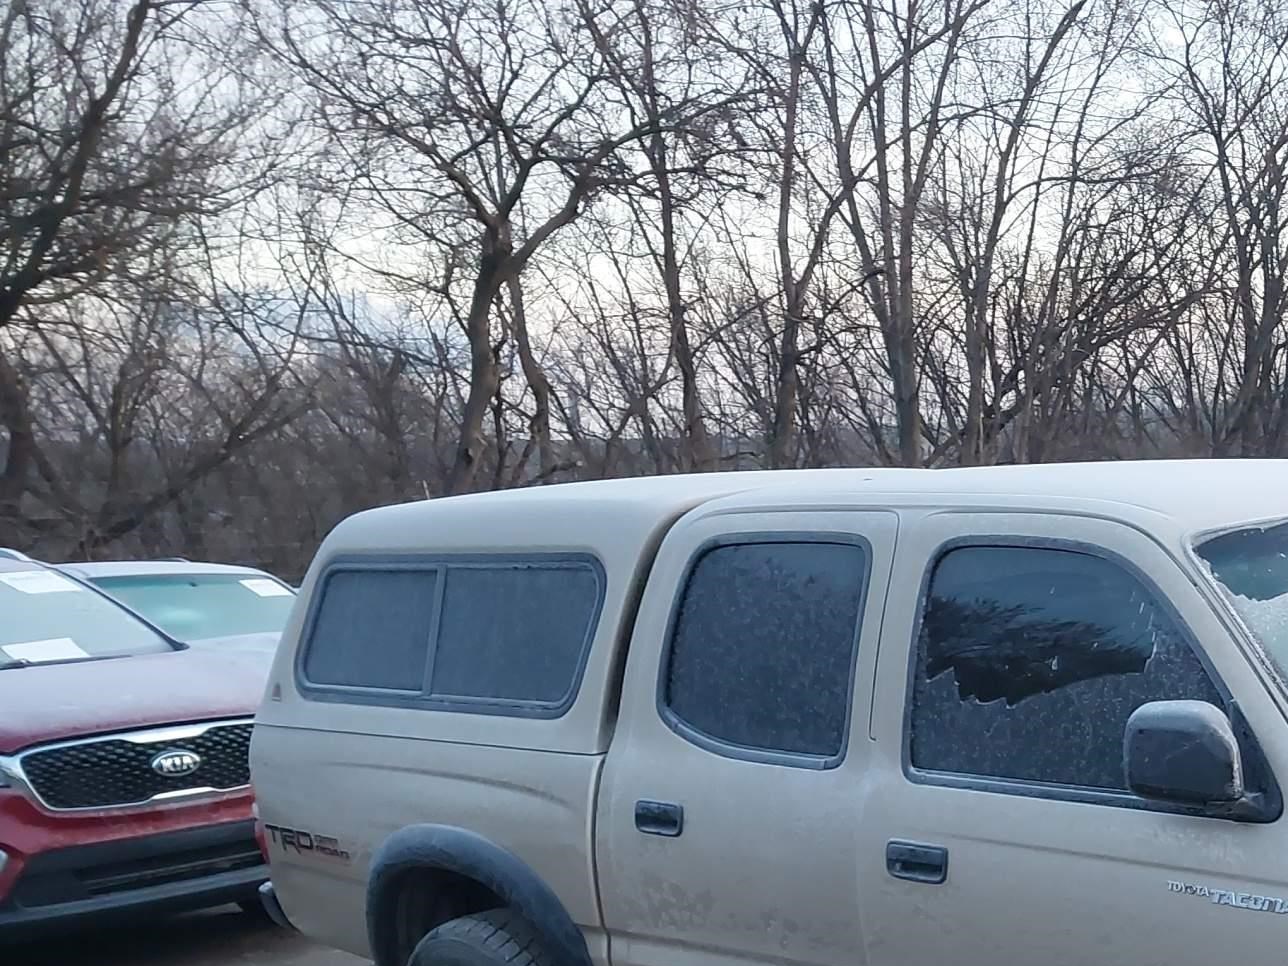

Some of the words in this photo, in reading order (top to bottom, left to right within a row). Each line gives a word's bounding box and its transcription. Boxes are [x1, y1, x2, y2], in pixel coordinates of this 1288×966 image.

[160, 755, 196, 773] KIA
[264, 823, 314, 855] TRD
[1167, 880, 1209, 897] TOYOTA
